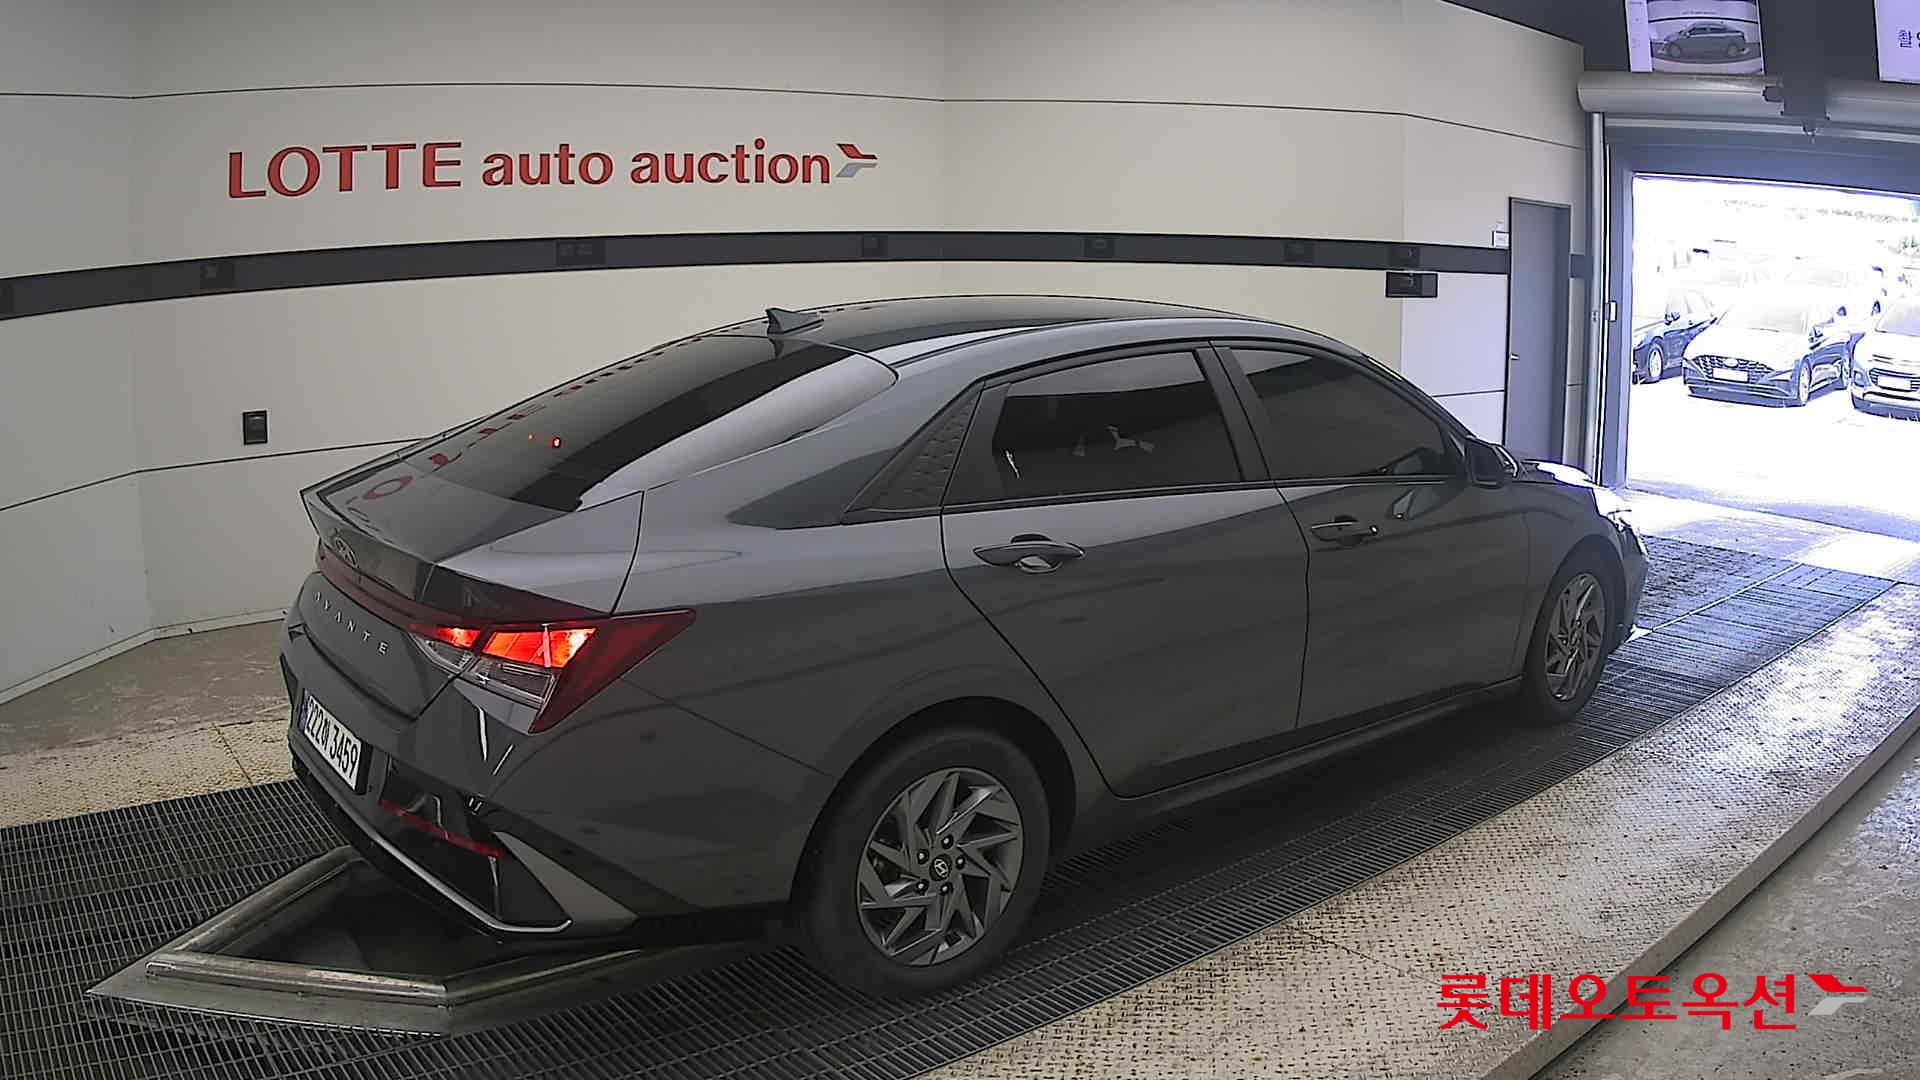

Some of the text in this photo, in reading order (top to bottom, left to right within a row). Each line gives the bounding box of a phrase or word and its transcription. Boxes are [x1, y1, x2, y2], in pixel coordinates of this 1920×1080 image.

[228, 138, 830, 199] LOTTE auto auction
[329, 724, 358, 779] 3459
